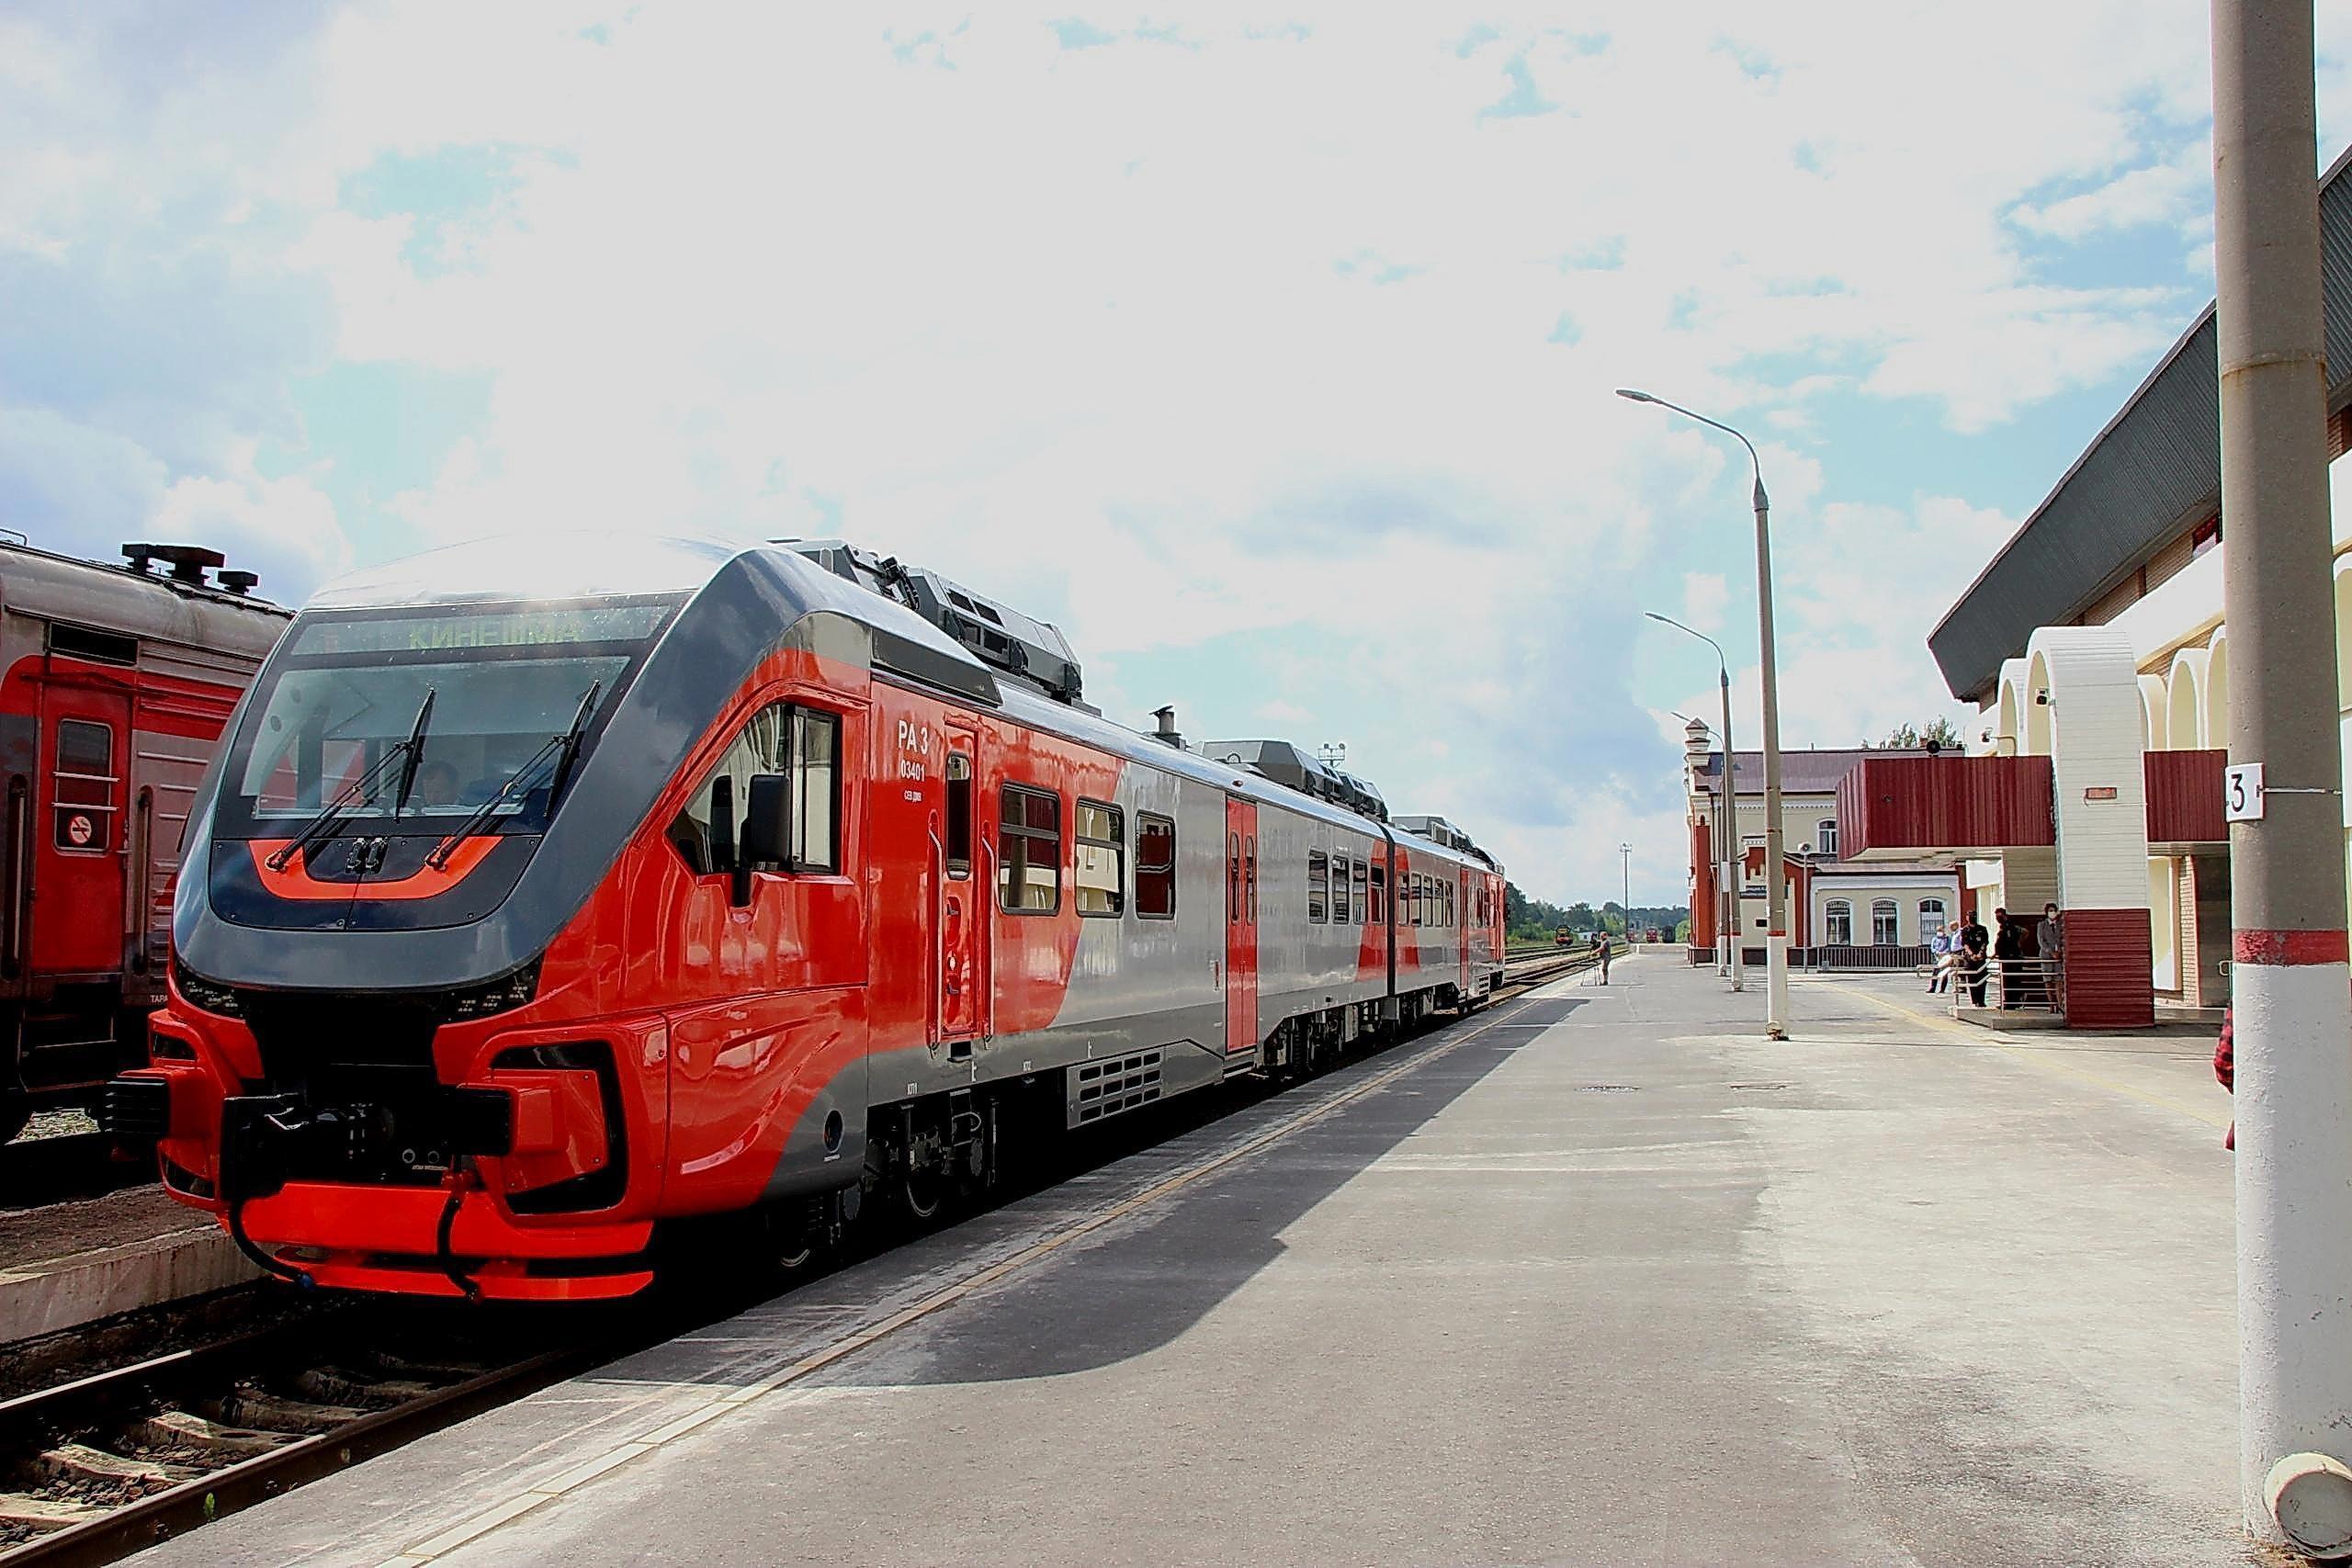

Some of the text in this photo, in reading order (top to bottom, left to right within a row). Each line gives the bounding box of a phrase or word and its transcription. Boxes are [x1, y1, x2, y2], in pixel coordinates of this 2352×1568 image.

[411, 616, 581, 649] КИНЕШМА
[899, 719, 928, 755] РА 3
[900, 759, 925, 783] 03401
[2232, 773, 2245, 813] 3
